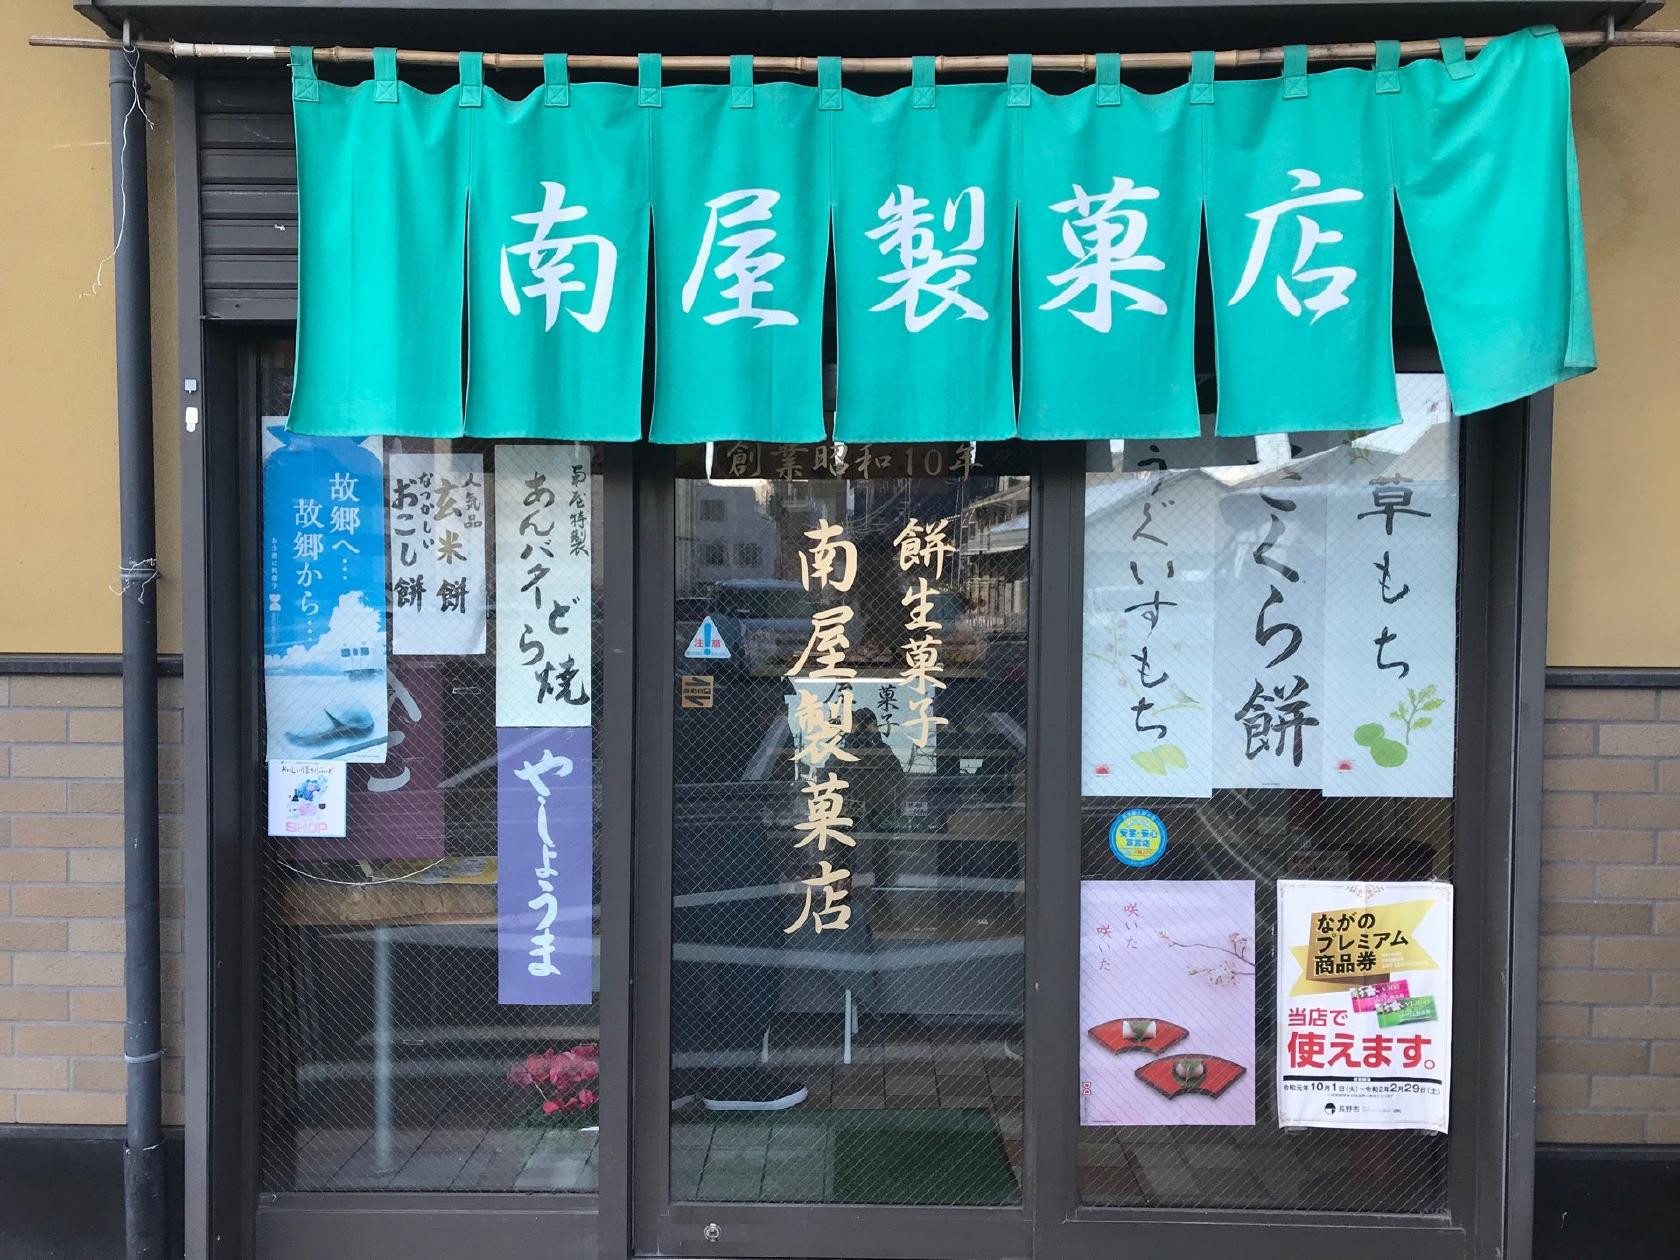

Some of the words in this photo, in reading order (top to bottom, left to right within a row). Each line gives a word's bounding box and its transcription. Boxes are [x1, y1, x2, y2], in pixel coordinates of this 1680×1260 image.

[499, 168, 1364, 335] 南屋製菓店
[726, 444, 983, 482] 創業昭和10年
[418, 471, 435, 550] なつかしい
[461, 472, 483, 529] 人気品
[392, 478, 427, 613] おこし餅
[433, 478, 470, 614] 玄米餅
[1357, 473, 1432, 680] 草もち
[893, 517, 957, 749] 餅生菓子
[783, 517, 862, 935] 南屋製菓店
[513, 749, 575, 977] やしょうま
[1096, 924, 1111, 972] 咲いた
[1124, 903, 1139, 950] 咲いた
[1316, 913, 1376, 933] ながの
[1316, 929, 1409, 954] プレミアム
[1315, 952, 1377, 976] 商品券
[1287, 1007, 1349, 1028] 当店で
[1287, 1031, 1436, 1071] 使えます。
